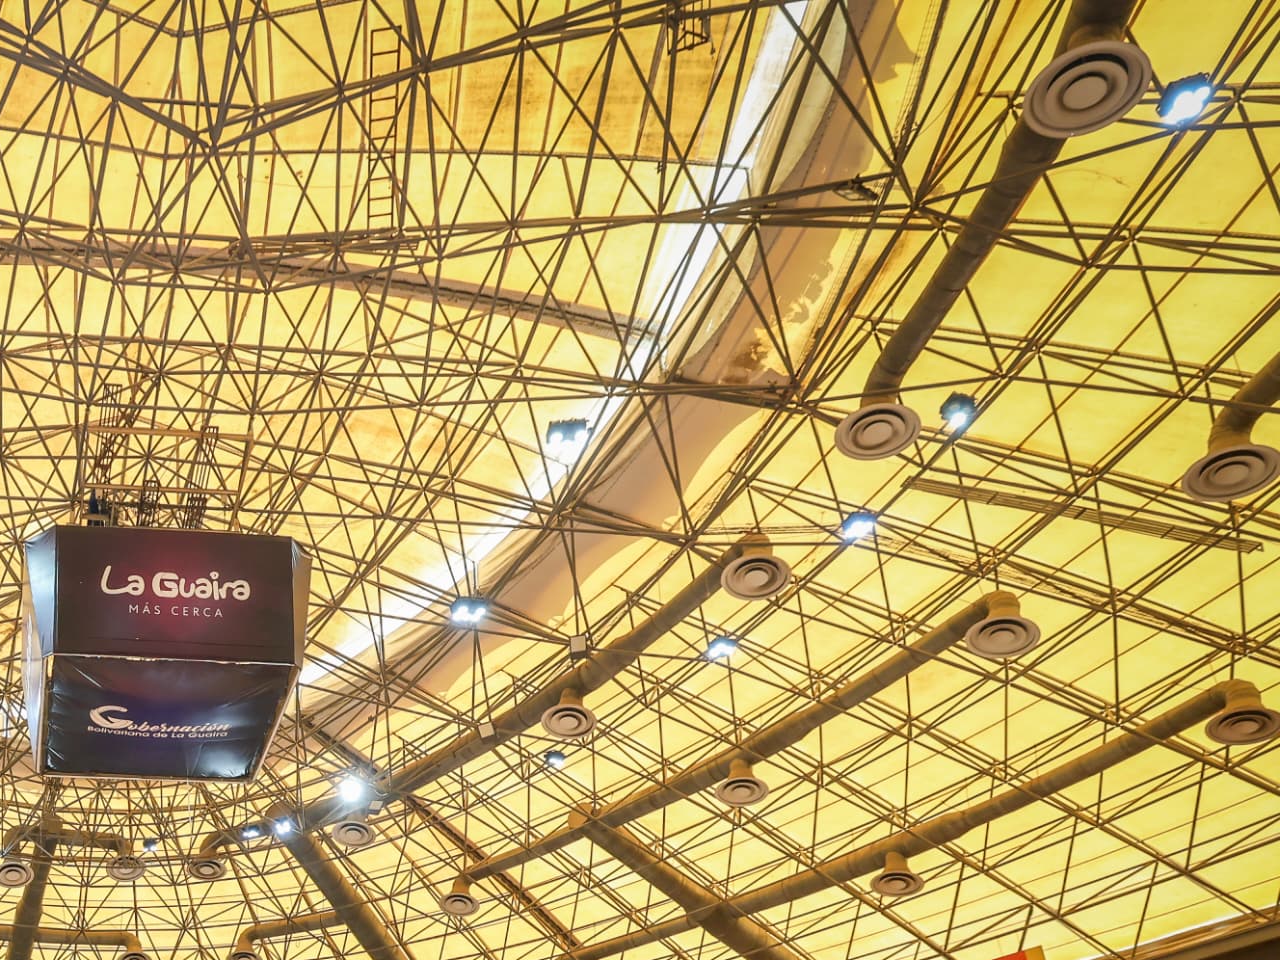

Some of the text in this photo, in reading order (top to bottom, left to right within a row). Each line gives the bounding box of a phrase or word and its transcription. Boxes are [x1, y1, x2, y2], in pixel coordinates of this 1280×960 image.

[100, 565, 251, 600] La Guaira
[128, 602, 223, 618] MÁS CERCA
[89, 705, 231, 733] Gobernación
[87, 725, 150, 738] Bolivariana
